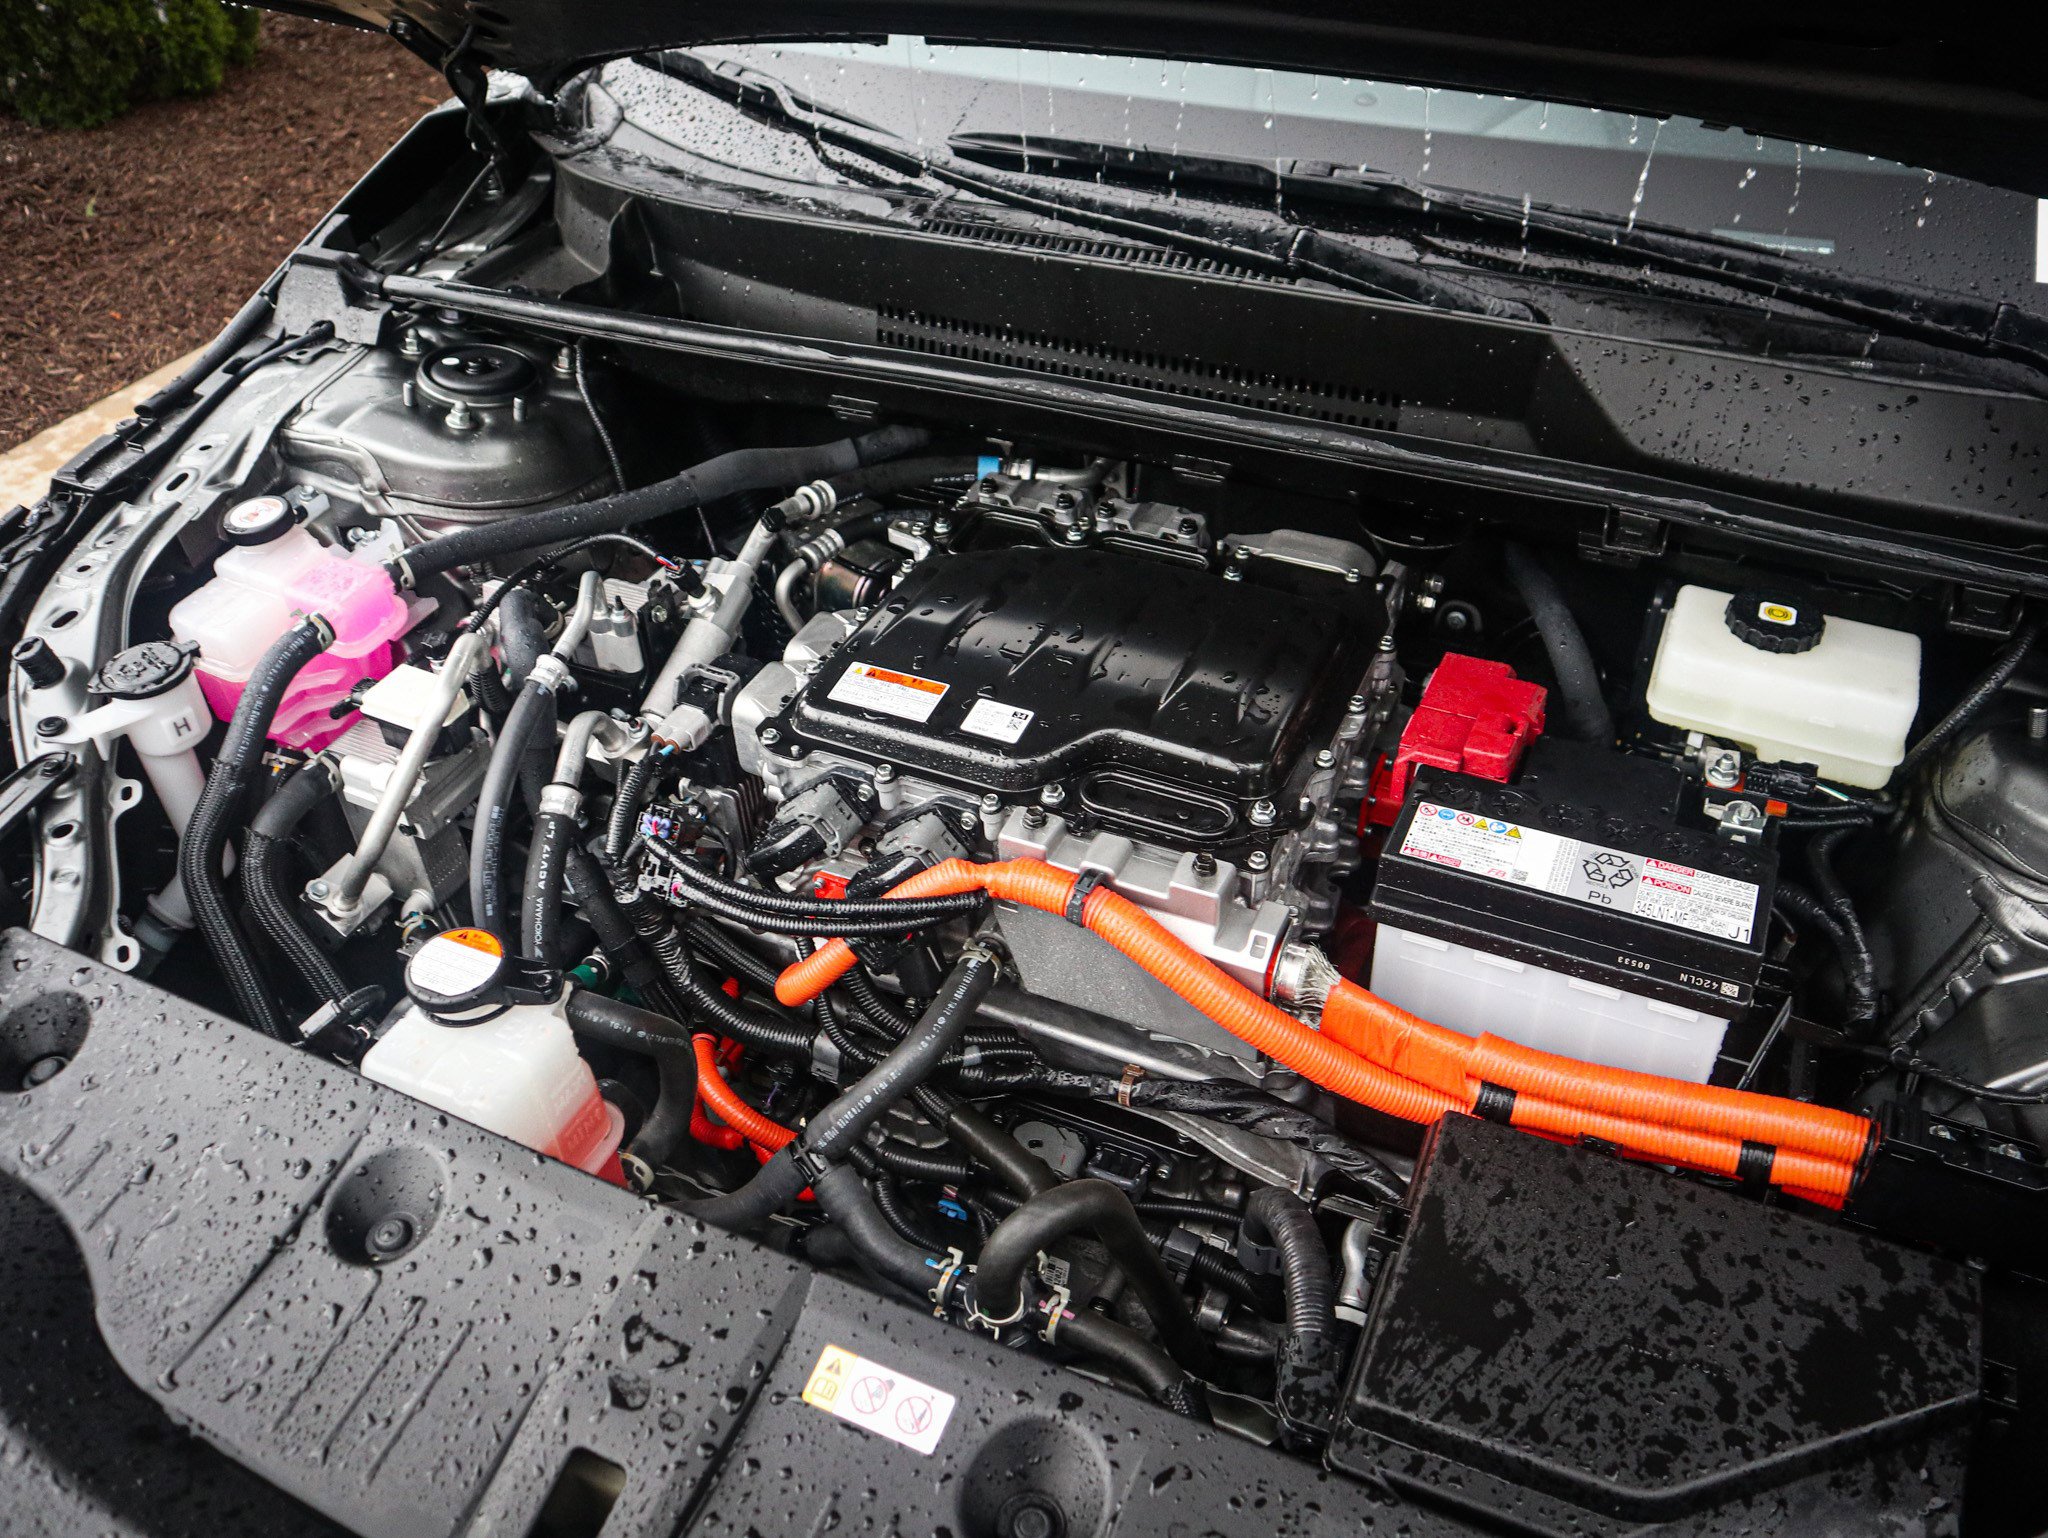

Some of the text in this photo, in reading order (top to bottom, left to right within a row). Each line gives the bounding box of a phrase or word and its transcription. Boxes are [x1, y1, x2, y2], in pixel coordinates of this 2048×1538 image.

[173, 716, 192, 737] H
[1657, 861, 1756, 892] DANGER EXPLOSIVE GASES
[1588, 891, 1611, 904] Pb
[1653, 878, 1753, 910] POISON CAUSES SEVERE BURNS
[535, 897, 545, 945] YOKOHAMA
[1617, 956, 1650, 970] 00533
[1680, 973, 1719, 990] 42CLN
